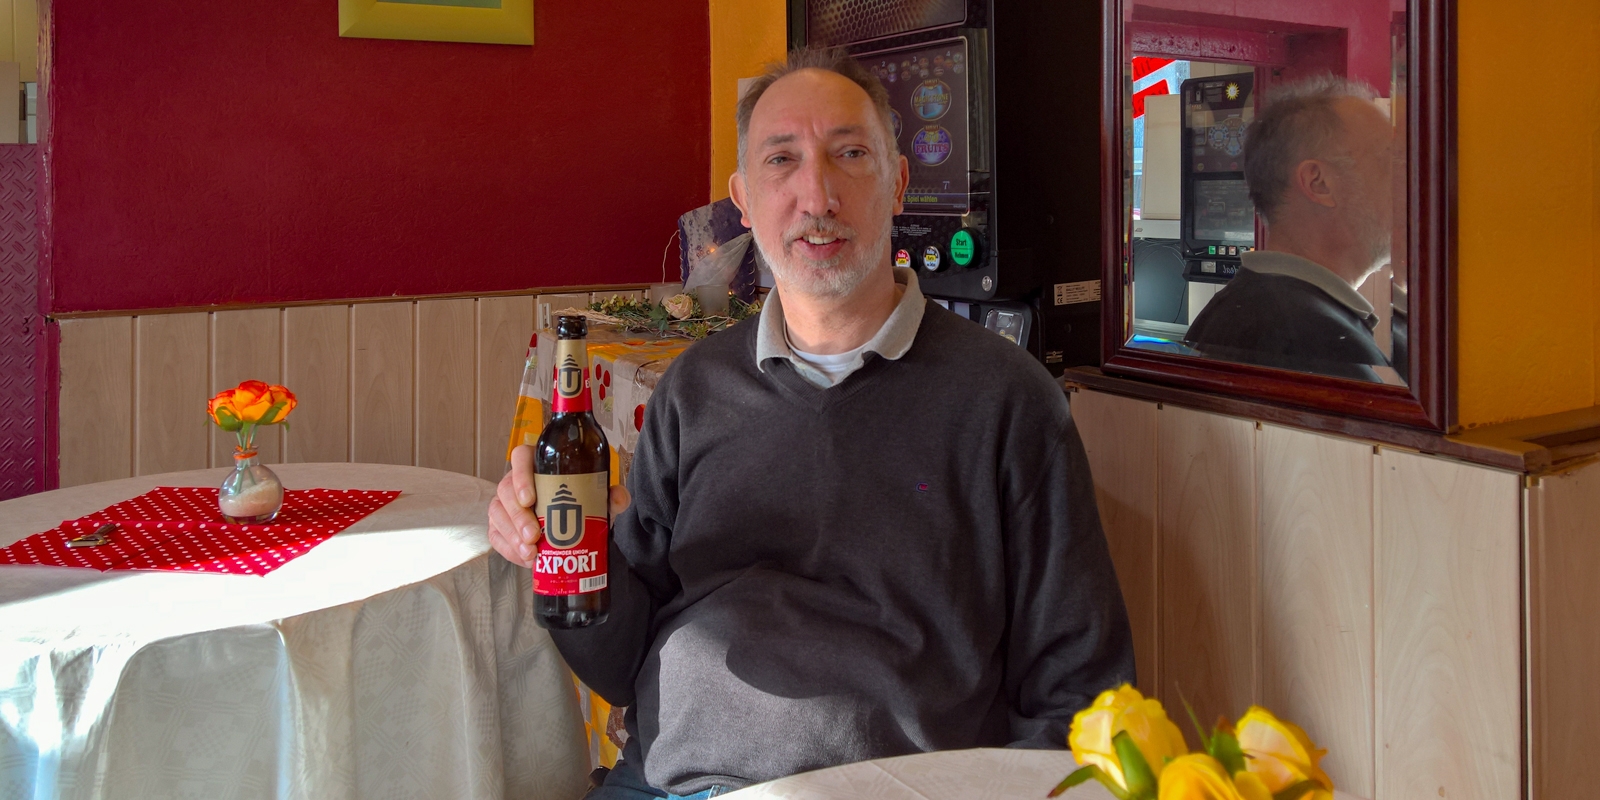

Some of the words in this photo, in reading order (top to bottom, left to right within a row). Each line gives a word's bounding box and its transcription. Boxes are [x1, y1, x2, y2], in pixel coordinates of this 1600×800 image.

[915, 143, 949, 154] FRUITS
[942, 180, 950, 190] 7
[907, 194, 919, 204] Spiel
[955, 238, 967, 246] Start
[550, 508, 578, 541] U
[535, 550, 599, 574] EXPORT
